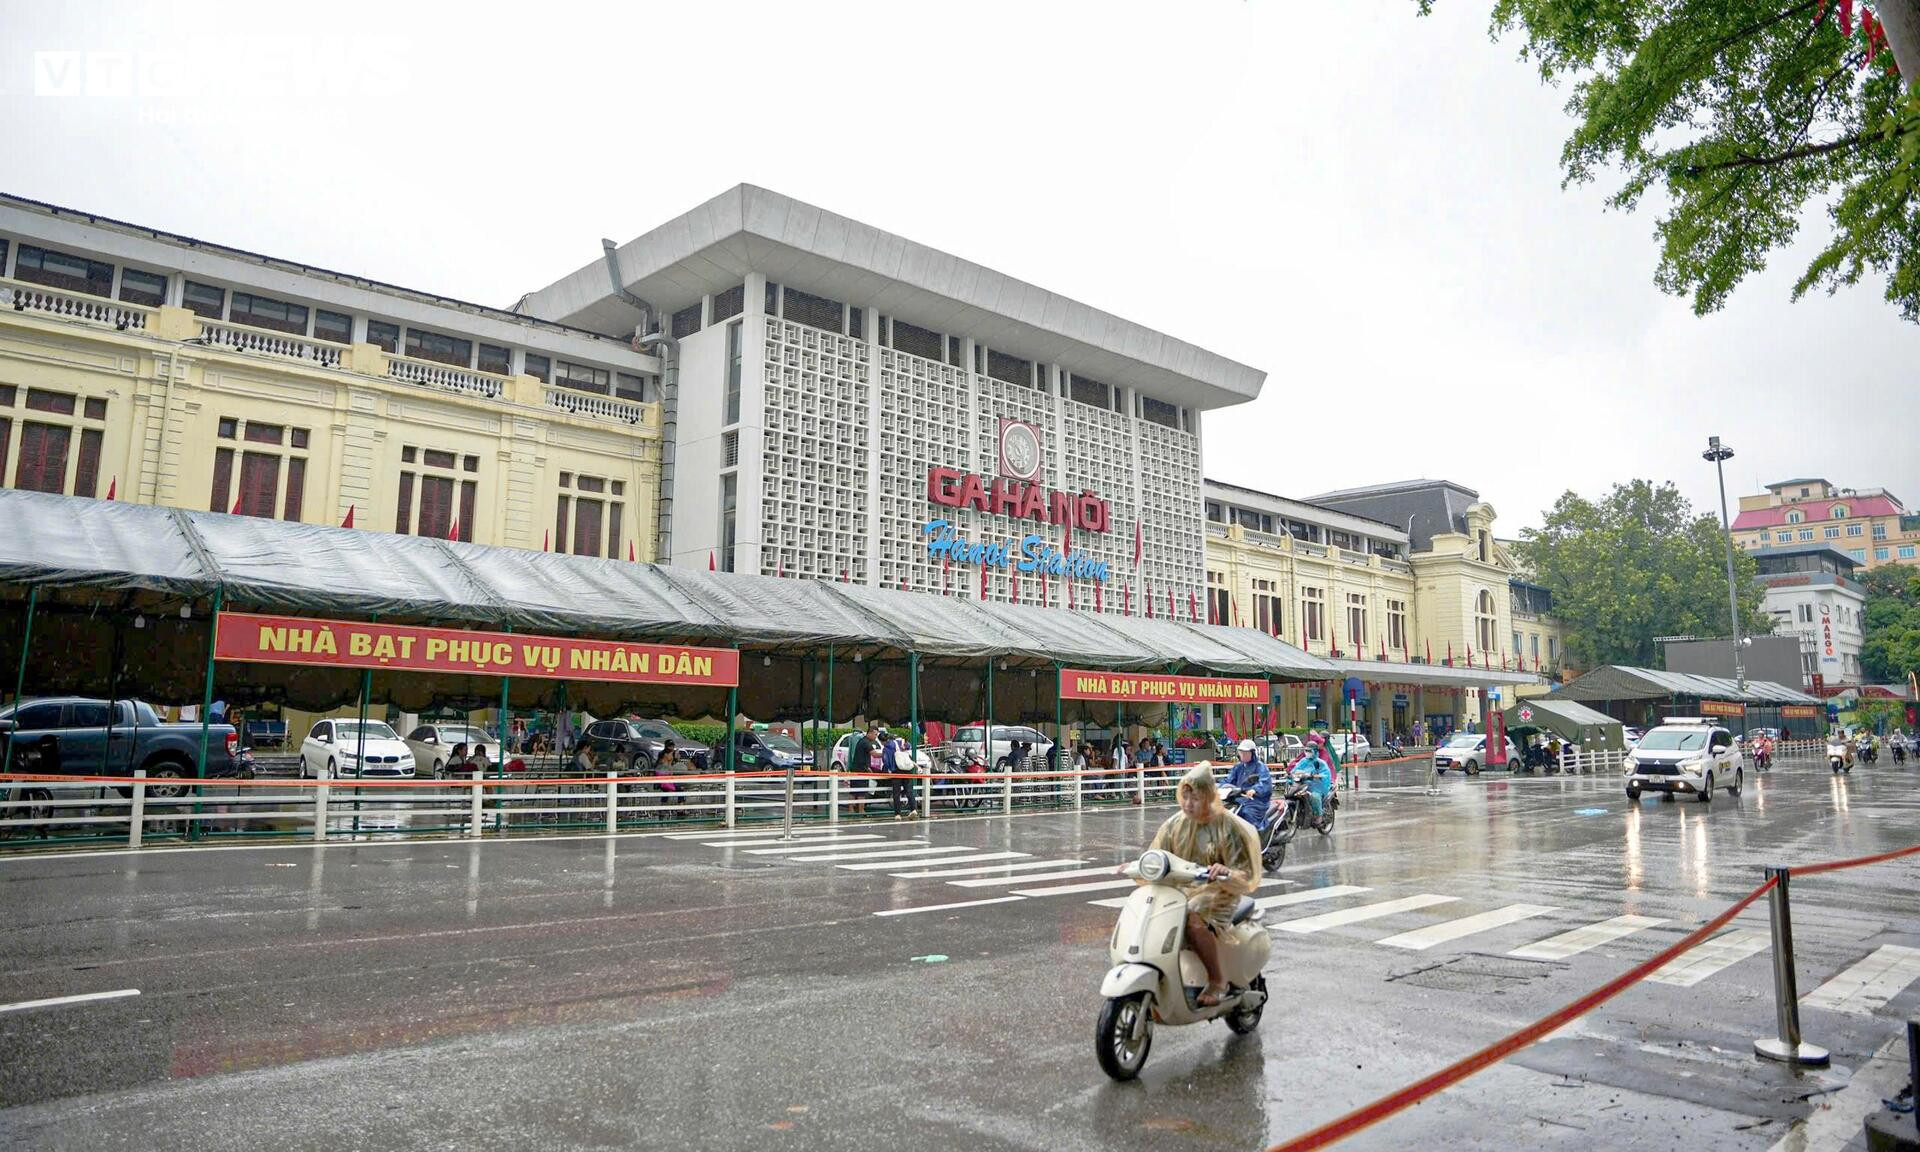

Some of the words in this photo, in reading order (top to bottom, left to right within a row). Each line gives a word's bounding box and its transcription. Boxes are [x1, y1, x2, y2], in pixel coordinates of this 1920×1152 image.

[928, 467, 990, 512] GA
[991, 479, 1048, 521] HÀ
[924, 519, 1013, 568] Hanoi
[1017, 534, 1109, 582] Station
[259, 625, 338, 655] NHÀ
[350, 632, 416, 663] BẠT
[426, 638, 513, 668] PHỤC
[523, 645, 561, 673] VỤ
[571, 648, 650, 673] NHÂN
[658, 651, 712, 677] DÂN
[1821, 616, 1833, 656] MANGO
[1077, 676, 1107, 694] NHÀ
[1111, 680, 1137, 697] BẠT
[1141, 680, 1176, 698] PHỤC
[1179, 682, 1196, 700] VỤ
[1199, 681, 1232, 698] NHÂN
[1235, 684, 1258, 698] DÂN
